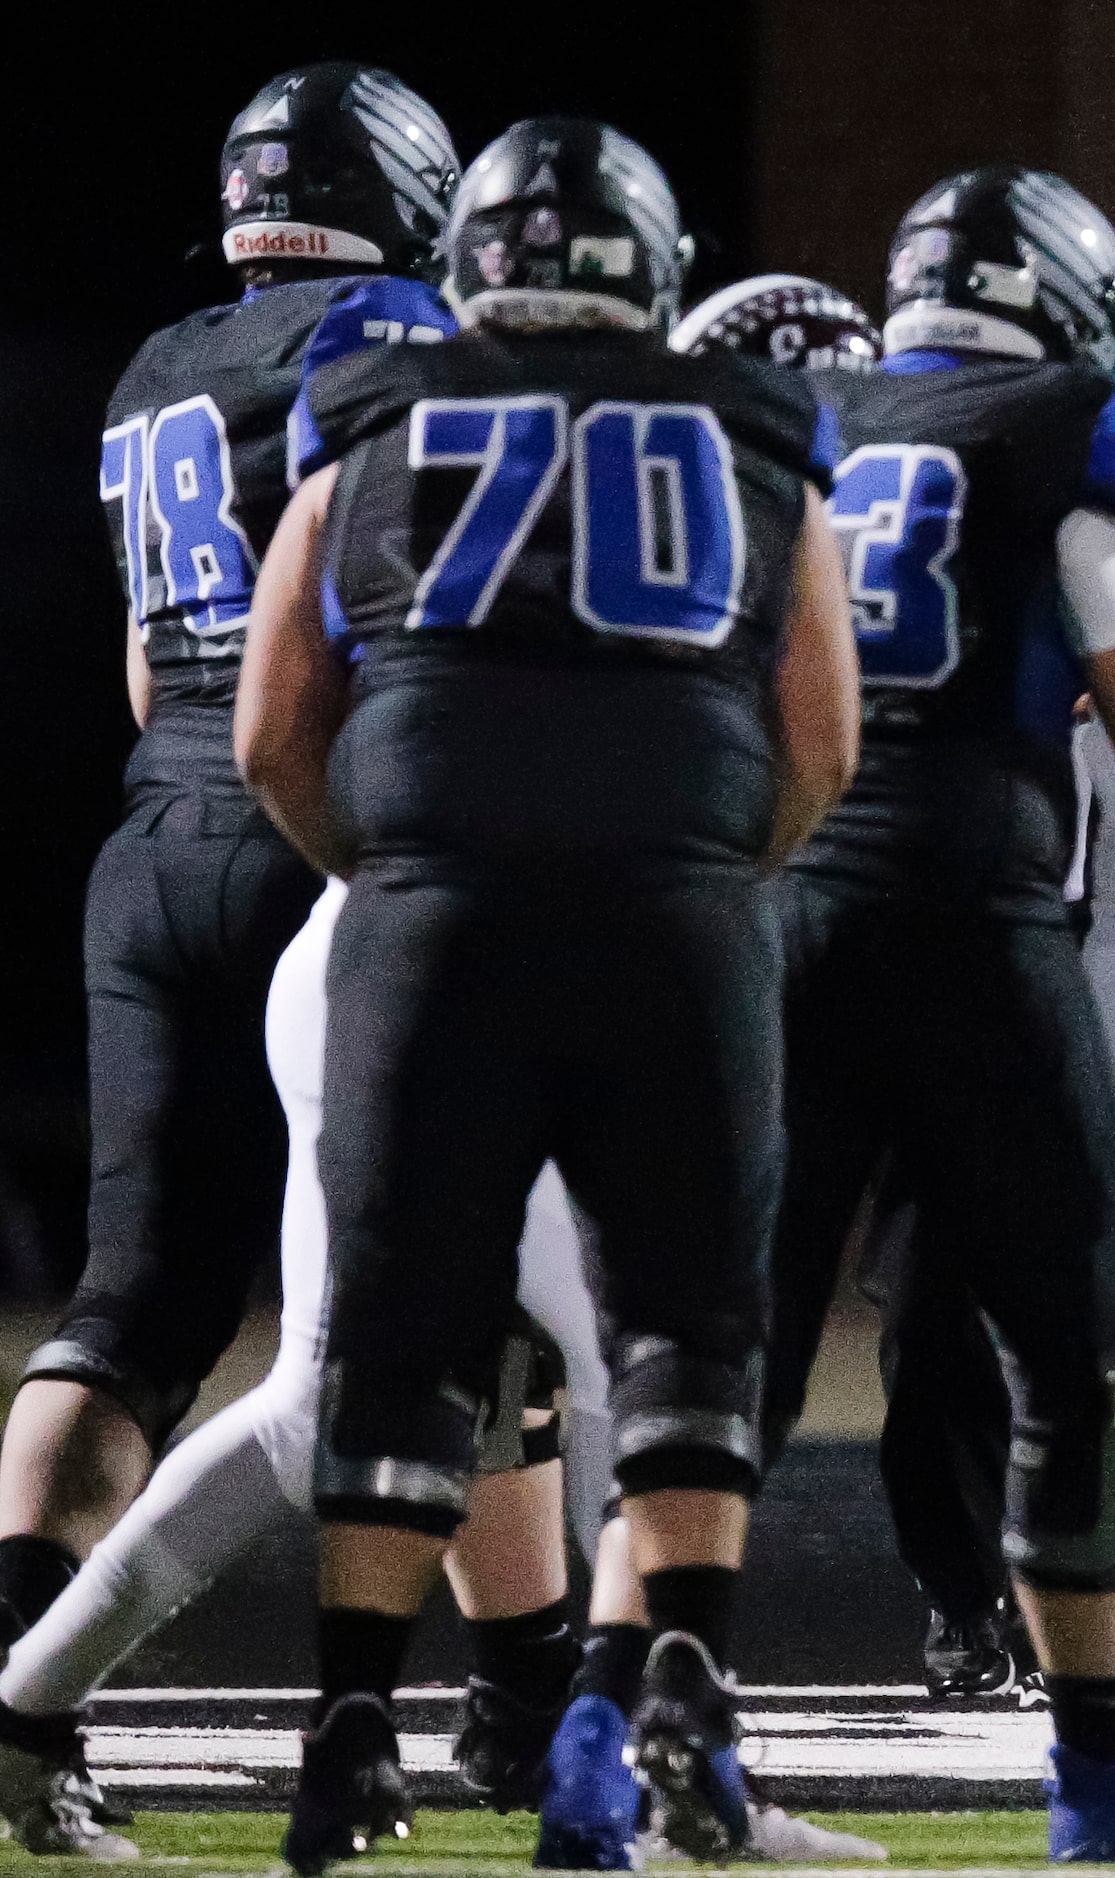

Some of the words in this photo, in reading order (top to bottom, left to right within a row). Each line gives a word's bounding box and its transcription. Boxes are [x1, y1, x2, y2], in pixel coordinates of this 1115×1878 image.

[232, 231, 330, 255] Riddell
[100, 394, 253, 642] 78
[404, 392, 747, 649] 70
